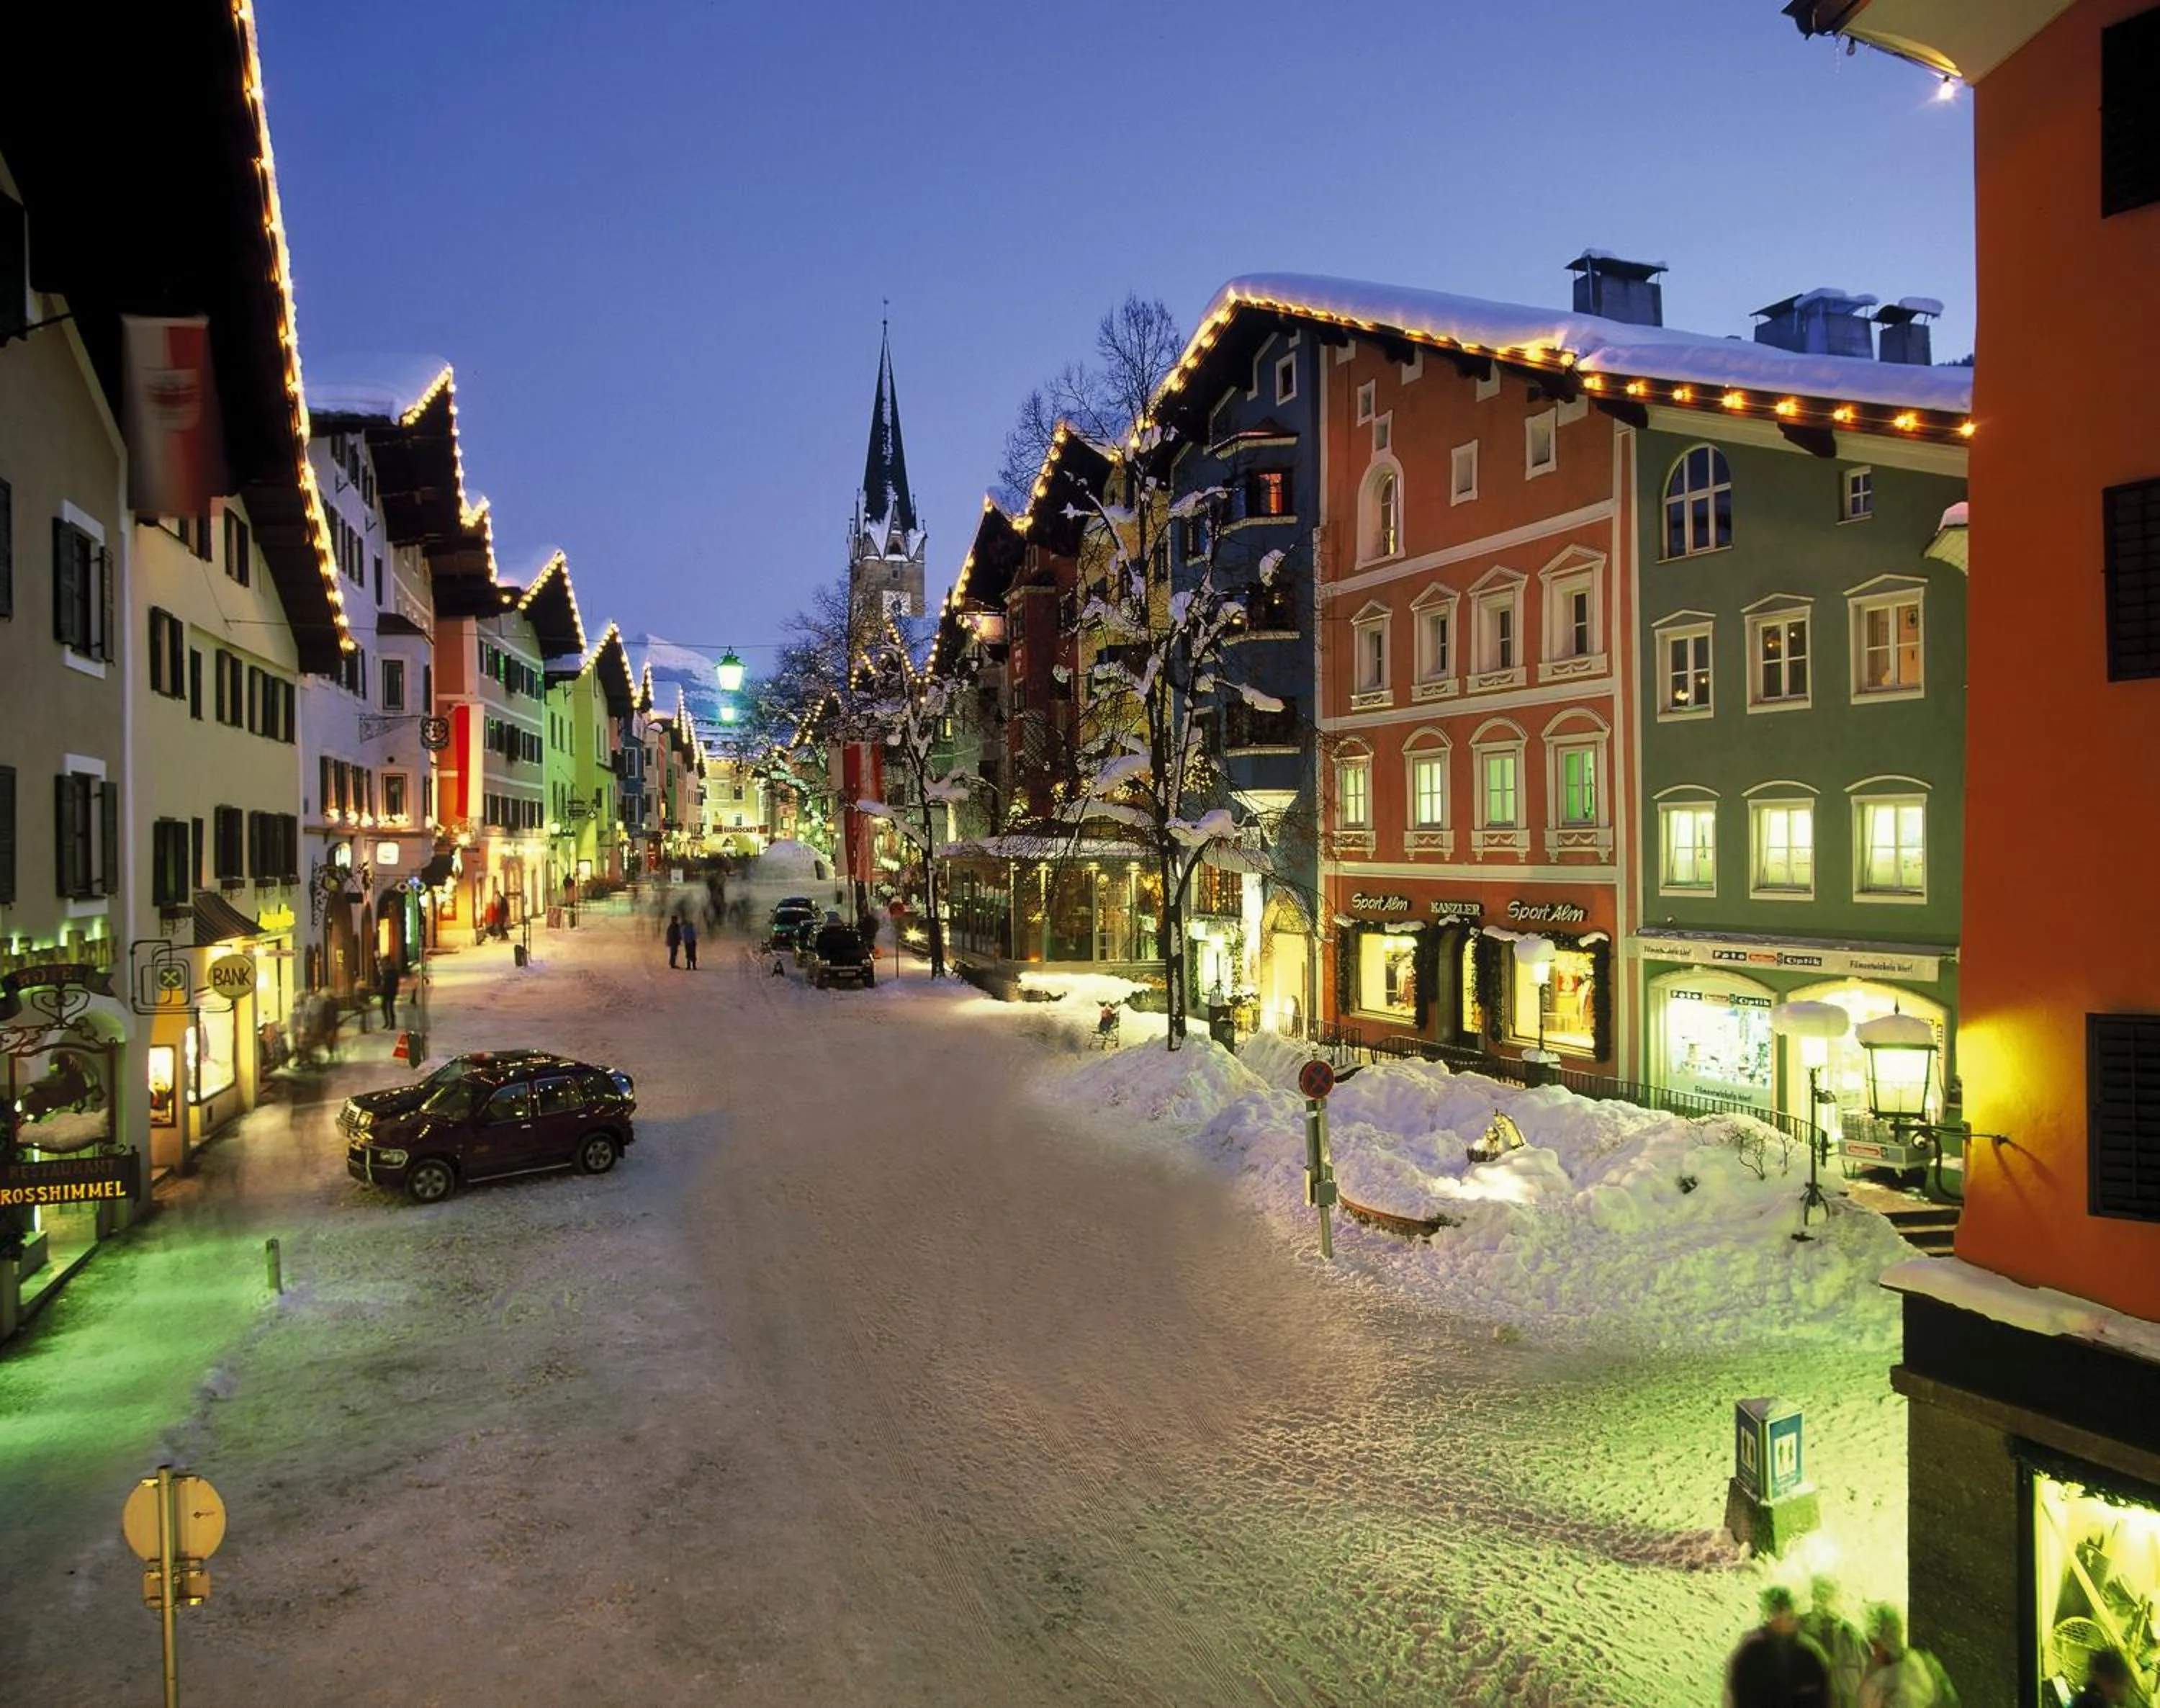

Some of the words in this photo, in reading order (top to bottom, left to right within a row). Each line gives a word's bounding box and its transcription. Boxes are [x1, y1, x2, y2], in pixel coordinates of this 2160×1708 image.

[1351, 892, 1384, 910] Sport
[1383, 896, 1408, 911] Alm
[1431, 902, 1480, 915] KANZLER
[1507, 900, 1549, 920] Sport
[1548, 904, 1584, 922] Alm
[1714, 950, 1746, 961] Foto
[1786, 956, 1822, 966] Optik
[212, 967, 251, 986] BANK
[9, 1159, 116, 1179] RESTAURANT
[0, 1180, 127, 1205] ROSSHIMMEL
